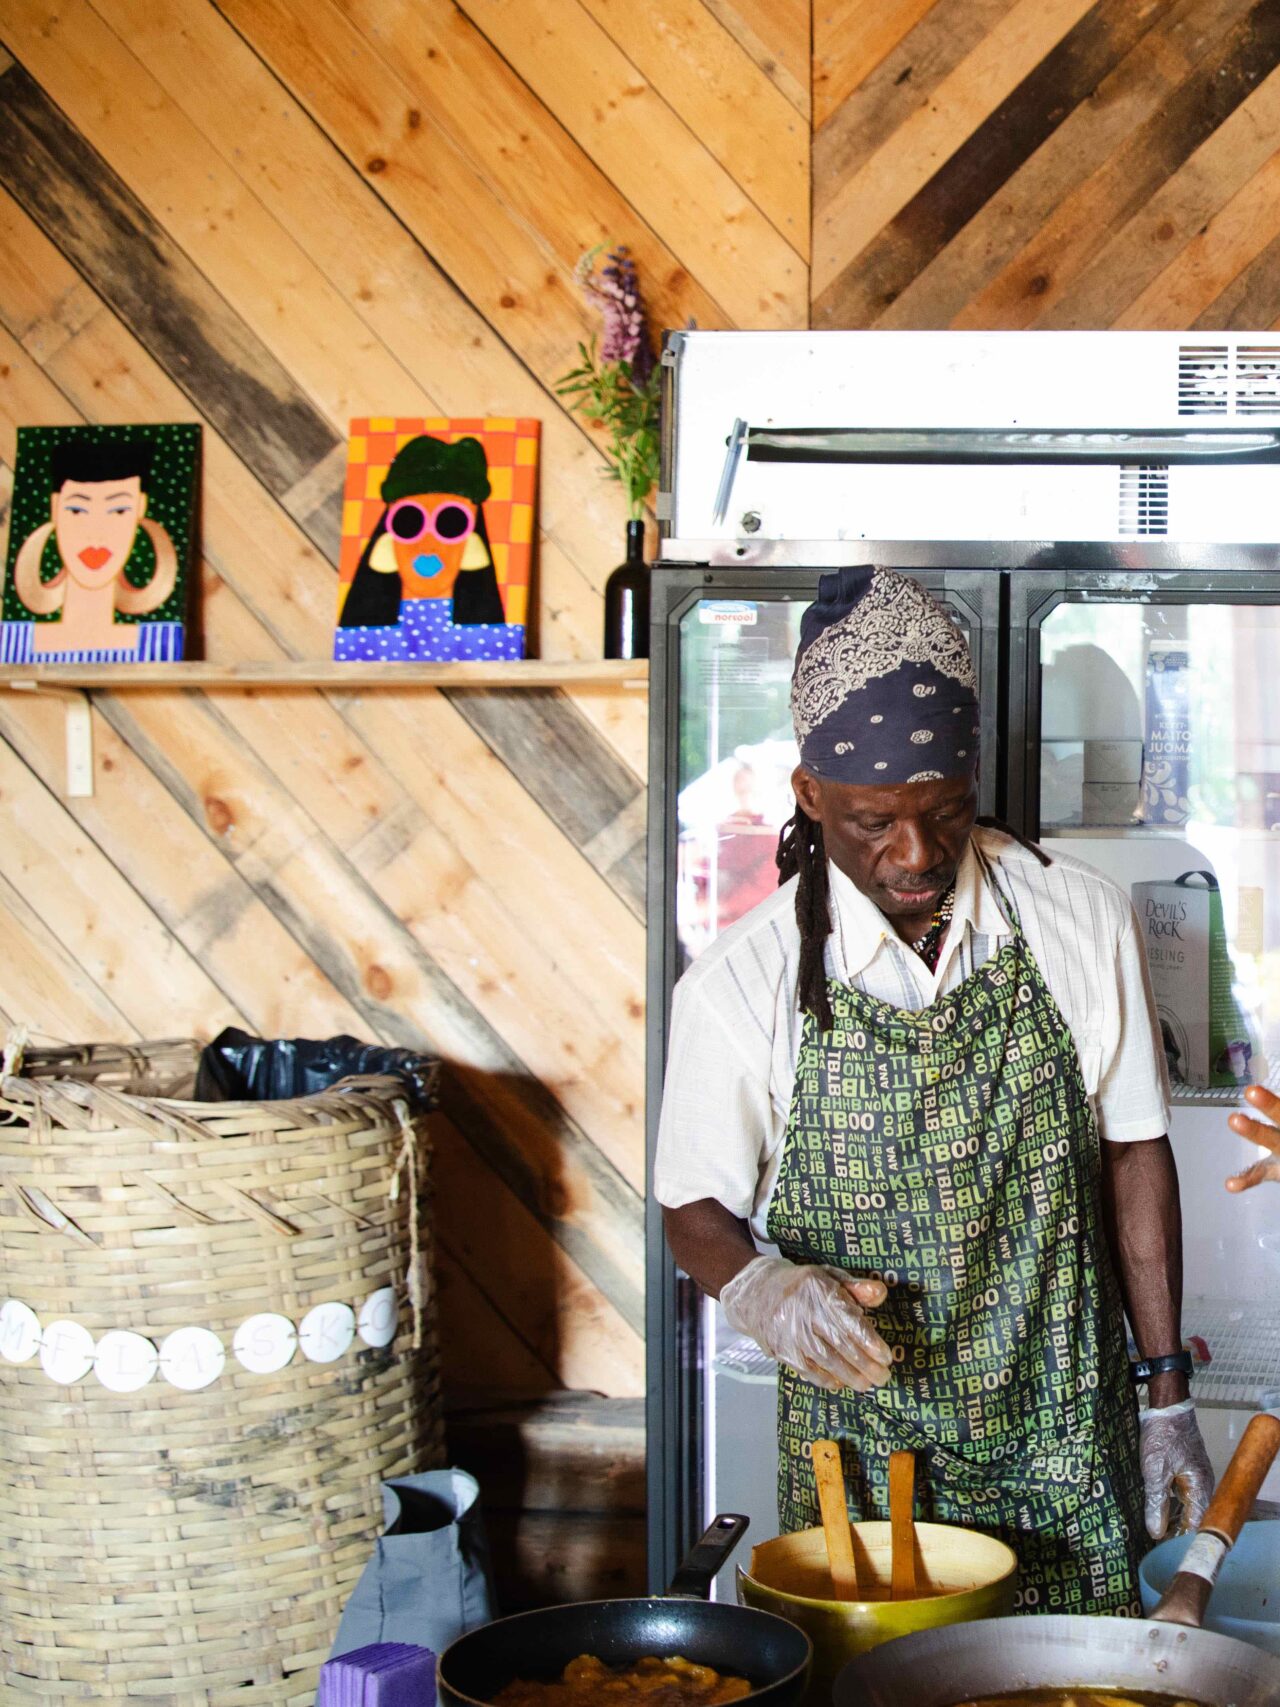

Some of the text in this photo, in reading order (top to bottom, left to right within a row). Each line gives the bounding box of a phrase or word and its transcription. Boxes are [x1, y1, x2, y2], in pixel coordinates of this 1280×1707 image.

[1149, 742, 1194, 753] JUOMA
[880, 1064, 889, 1088] ANA
[939, 1080, 958, 1092] ANA
[1033, 1085, 1050, 1098] ANA
[848, 1134, 866, 1143] ANA
[886, 1146, 898, 1171] ANA
[953, 1160, 973, 1172] ANA
[1045, 1162, 1064, 1176] ANA
[802, 1182, 812, 1206] ANA
[856, 1212, 879, 1221] ANA
[903, 1221, 914, 1245] ANA
[967, 1238, 983, 1250] ANA
[999, 1235, 1012, 1259] ANA
[1056, 1240, 1075, 1250] ANA
[1082, 1240, 1092, 1262] ANA
[913, 1302, 926, 1323] ANA
[971, 1311, 992, 1323] ANA
[1016, 1314, 1026, 1338] ANA
[796, 1384, 814, 1395] ANA
[919, 1377, 931, 1398] ANA
[984, 1391, 1005, 1403] ANA
[1023, 1388, 1032, 1411] ANA
[830, 1405, 839, 1427] ANA
[1048, 1486, 1069, 1495] ANA
[1080, 1503, 1100, 1517] ANA
[1020, 1505, 1032, 1530] ANA
